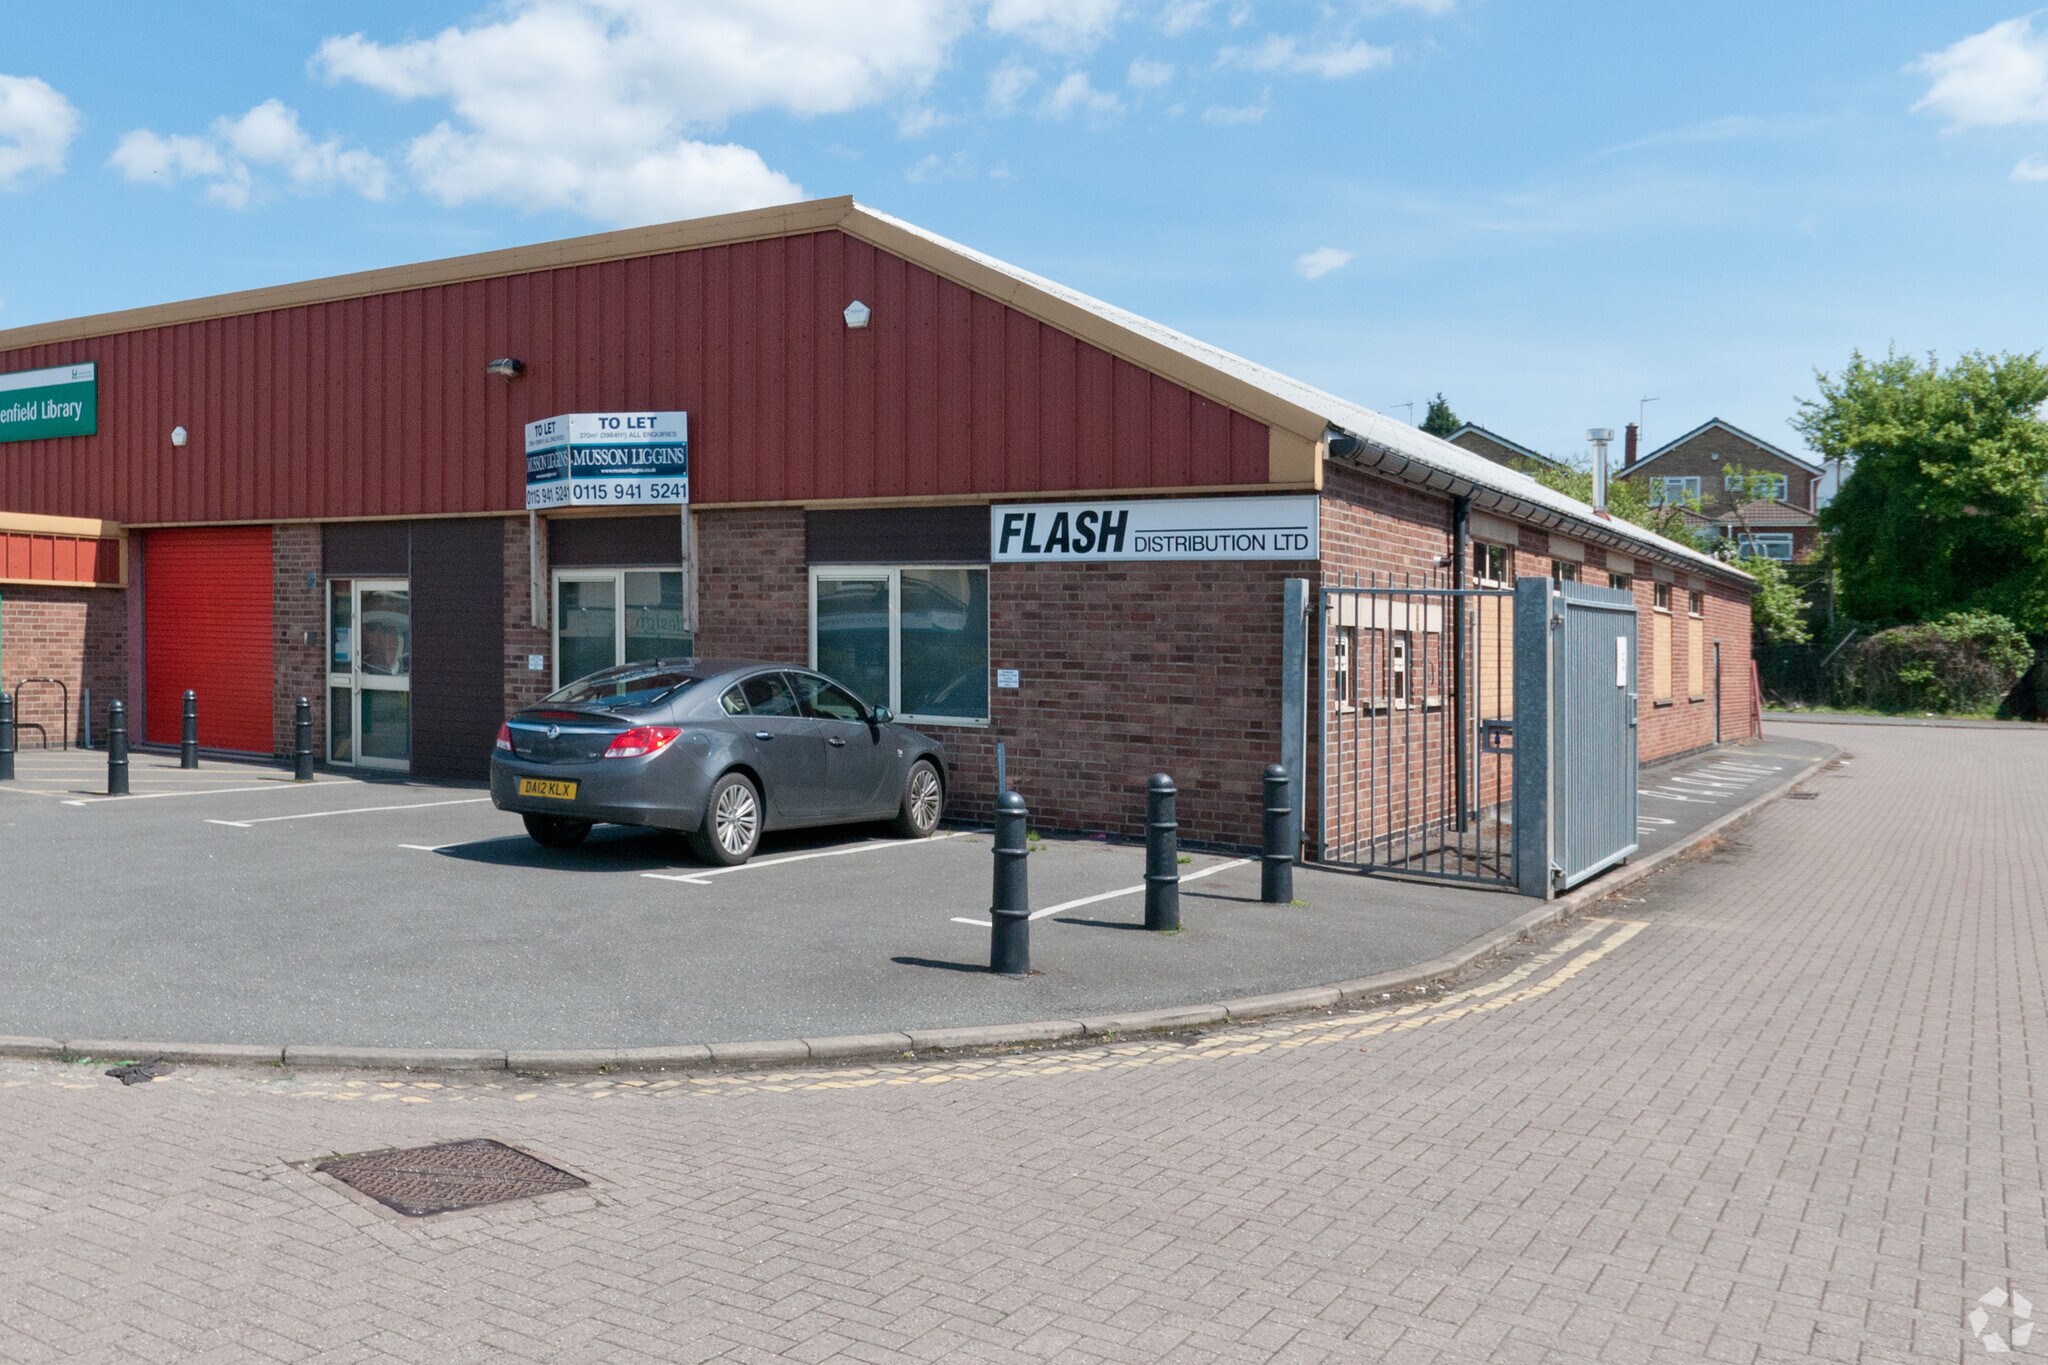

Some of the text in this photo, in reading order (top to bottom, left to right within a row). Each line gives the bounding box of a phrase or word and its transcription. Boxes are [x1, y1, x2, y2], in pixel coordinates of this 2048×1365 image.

[41, 399, 82, 422] Library
[534, 421, 556, 437] TO LET
[598, 416, 657, 430] TO LET
[643, 430, 678, 438] ENQUIRIES
[573, 447, 685, 466] MUSSON LIGGINS
[541, 488, 554, 503] 941
[573, 483, 687, 500] 0115 941 5241
[998, 509, 1308, 554] FLASH DISTRIBUTION LTD
[525, 781, 570, 796] DA12 KLX
